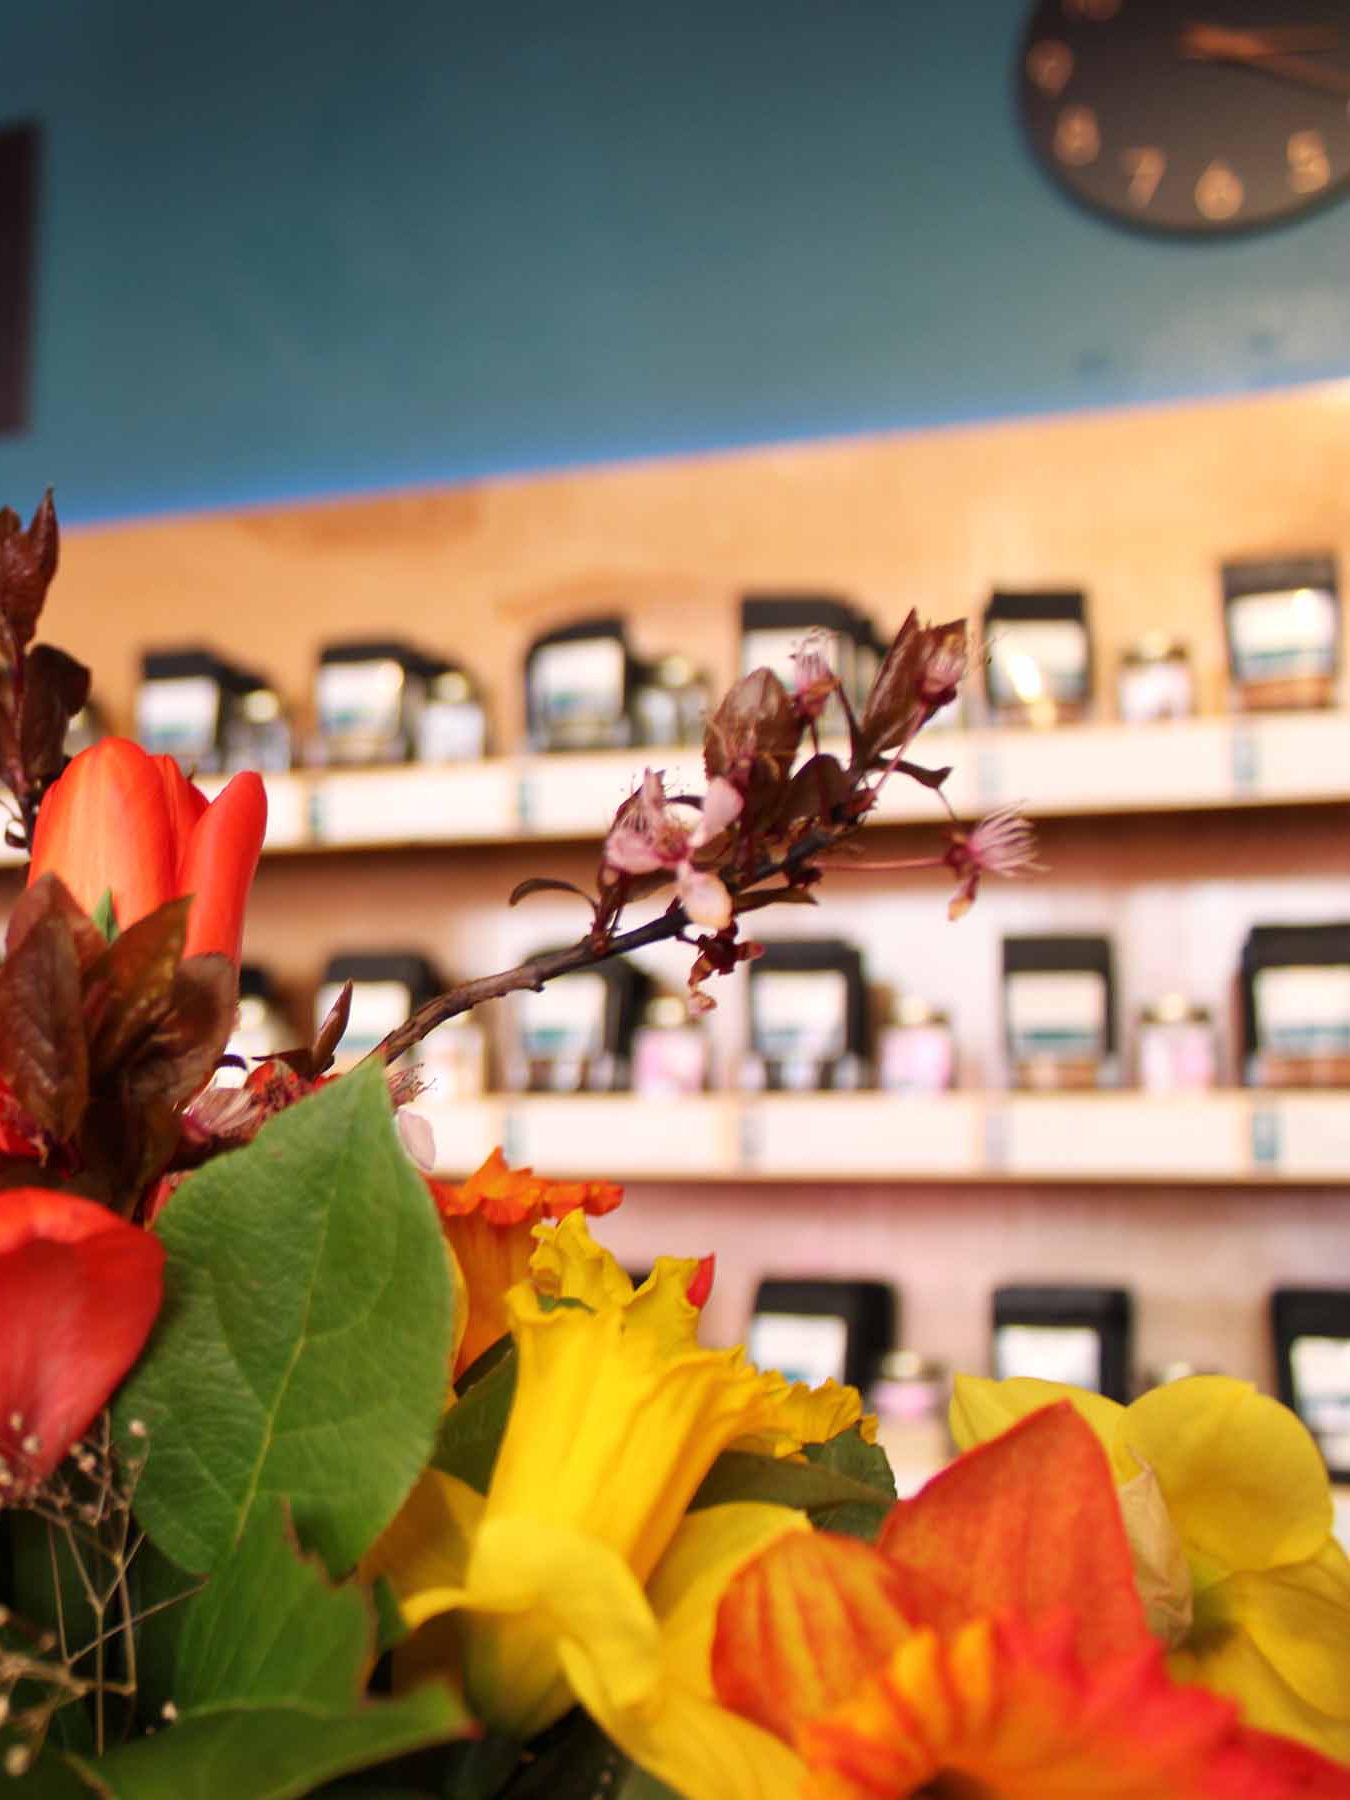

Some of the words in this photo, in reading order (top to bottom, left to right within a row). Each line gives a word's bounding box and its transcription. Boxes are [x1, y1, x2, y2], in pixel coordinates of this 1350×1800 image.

[1054, 104, 1100, 166] 8
[1287, 129, 1330, 194] 5
[1121, 146, 1166, 207] 7
[1195, 160, 1243, 220] 6
